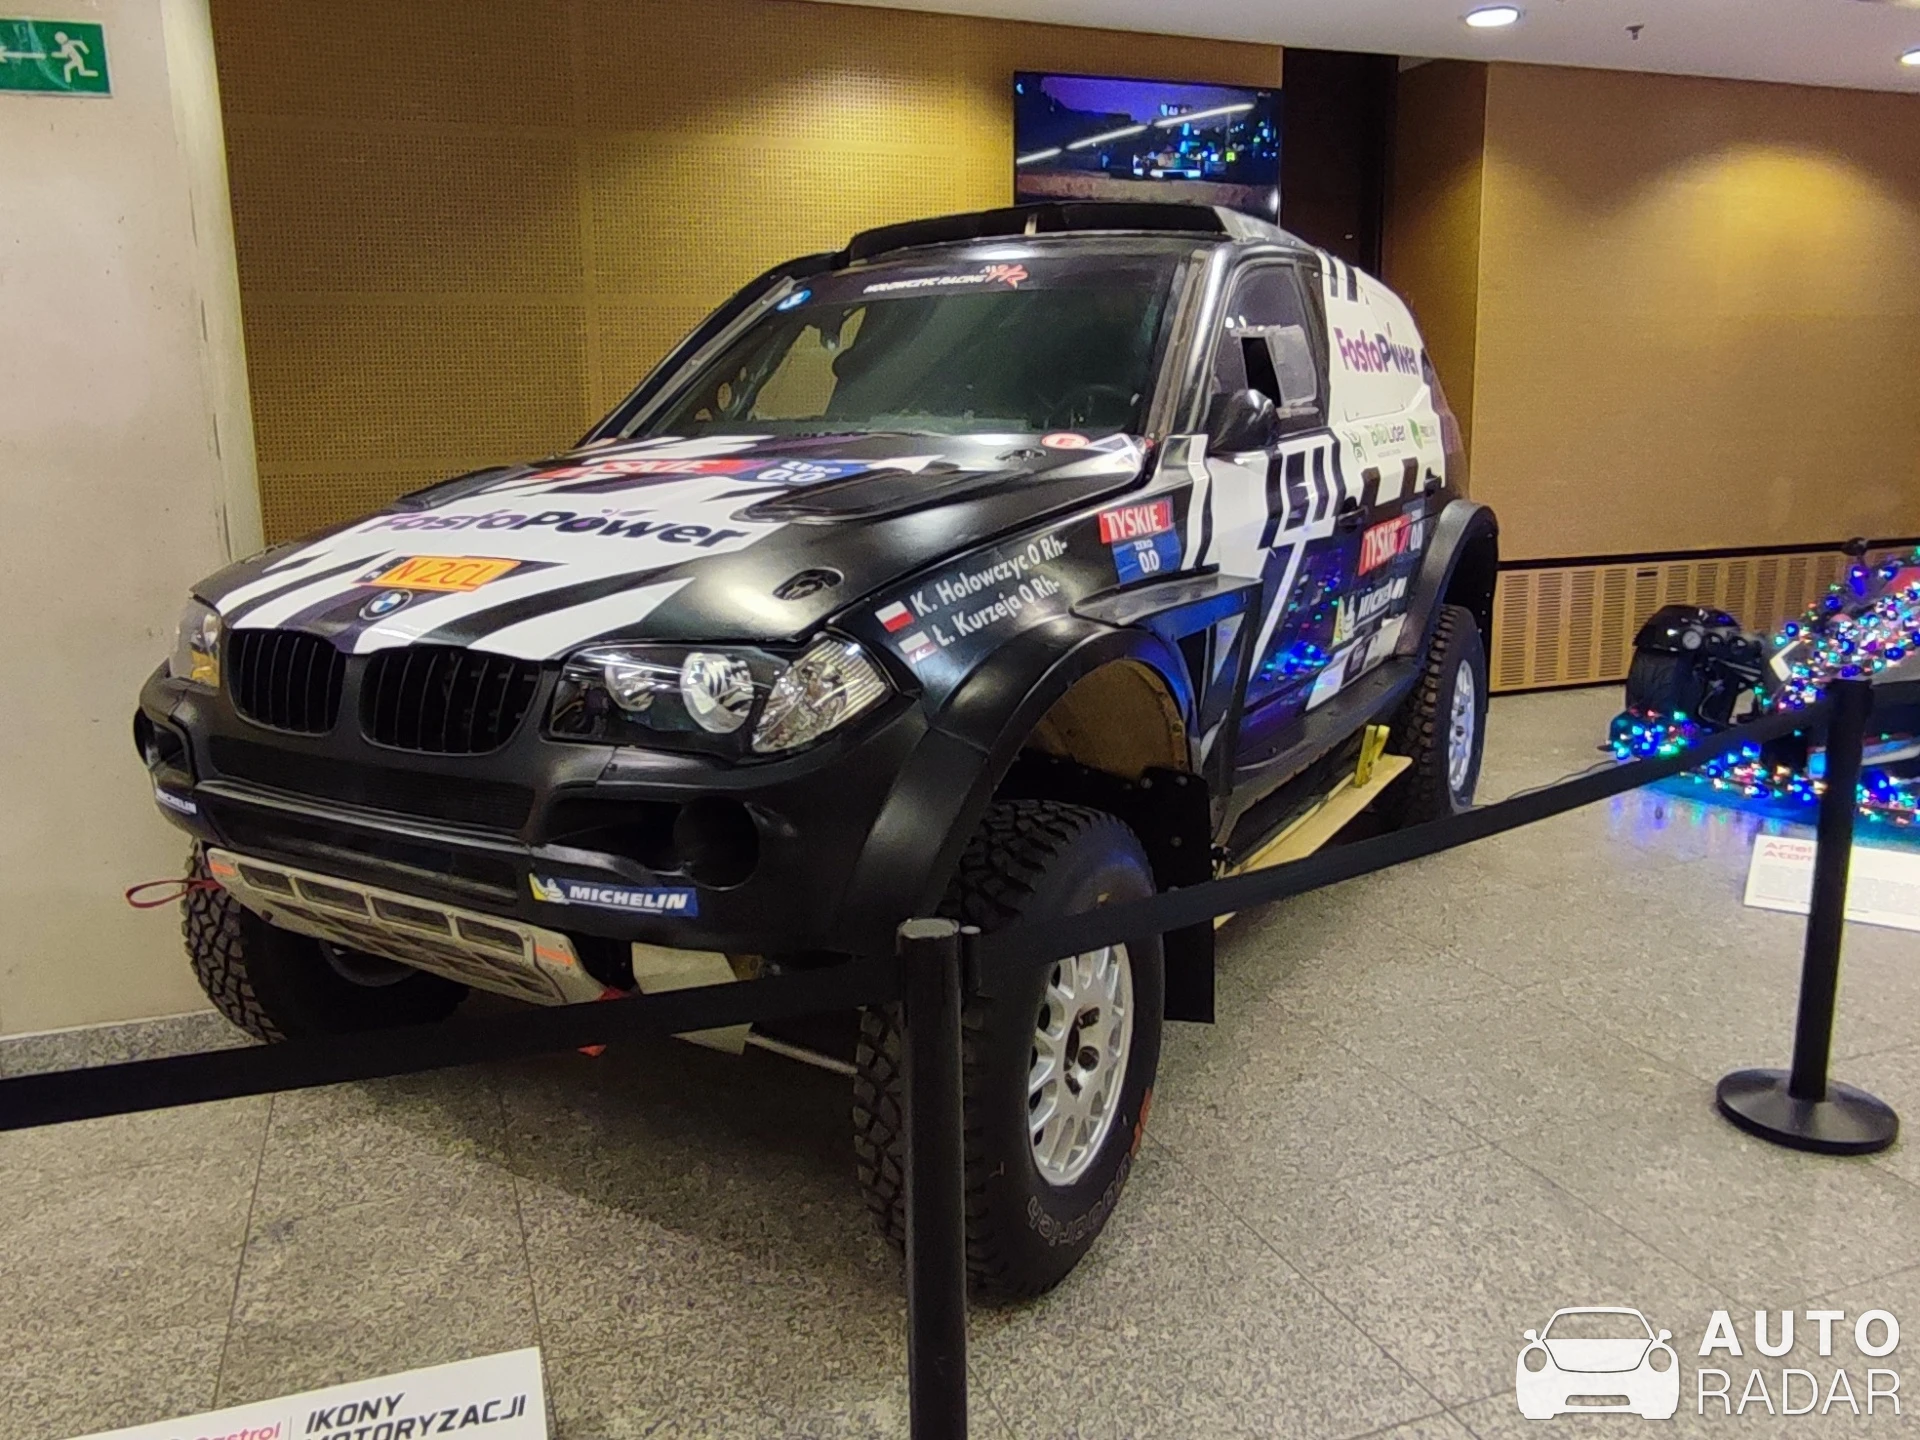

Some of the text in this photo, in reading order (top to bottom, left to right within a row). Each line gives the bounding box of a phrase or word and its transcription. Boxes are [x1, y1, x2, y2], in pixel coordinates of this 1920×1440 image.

[1102, 504, 1162, 540] TYSKIE
[910, 591, 938, 617] K.
[935, 554, 1029, 606] Hołowczyc
[1040, 535, 1068, 561] Rh-
[931, 624, 956, 647] Ł.
[951, 592, 1022, 637] Kurzeja
[1030, 575, 1061, 599] Rh-
[569, 885, 689, 910] MICHELIN
[196, 1421, 282, 1440] trol
[305, 1392, 405, 1434] IKONY
[306, 1394, 526, 1440] TORYZACJI
